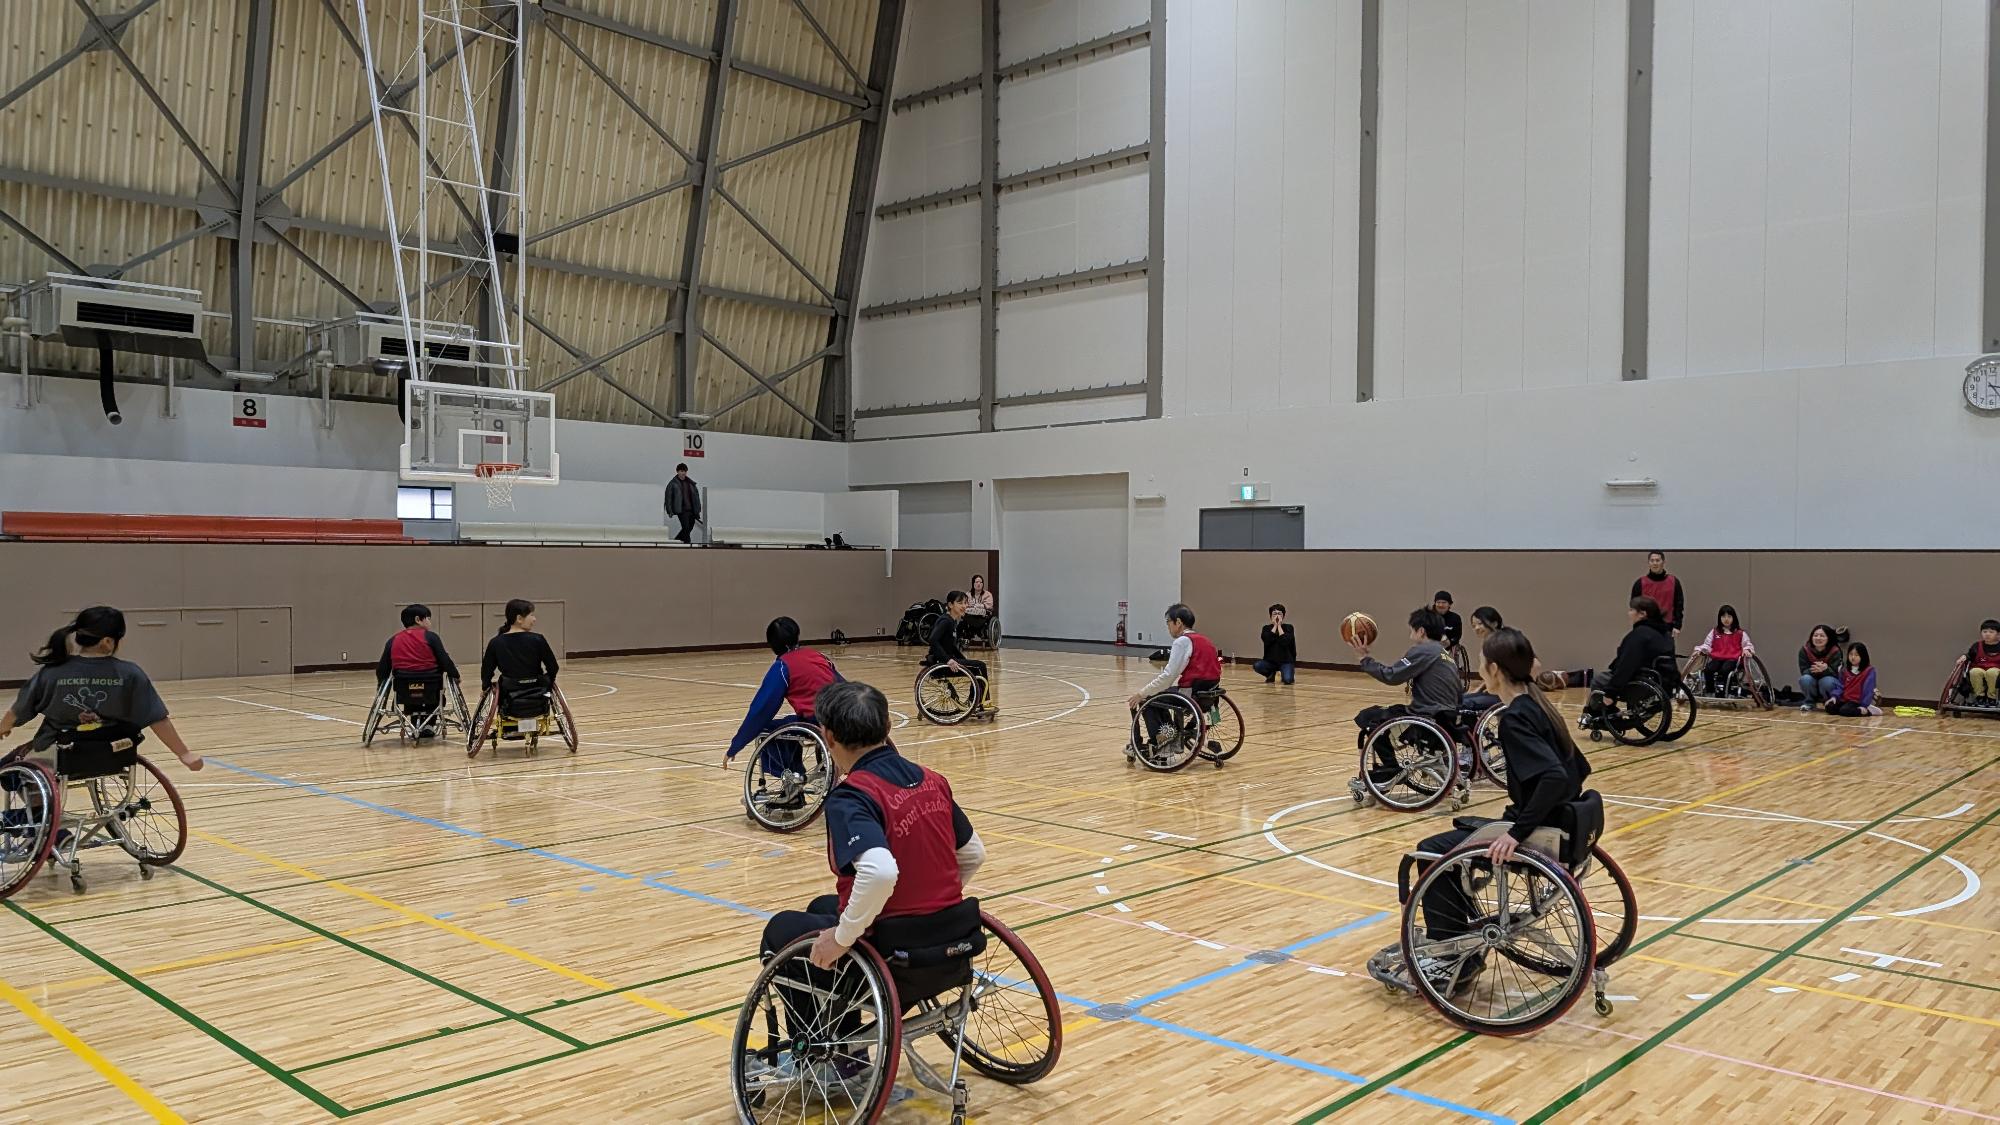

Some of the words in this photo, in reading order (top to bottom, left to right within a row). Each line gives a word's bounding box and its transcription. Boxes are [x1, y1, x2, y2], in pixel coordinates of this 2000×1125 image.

[243, 398, 257, 416] 8
[493, 418, 504, 432] 9
[686, 434, 703, 449] 10
[57, 677, 90, 686] MICKEY
[91, 678, 124, 686] MOUSE
[893, 804, 920, 838] Sport
